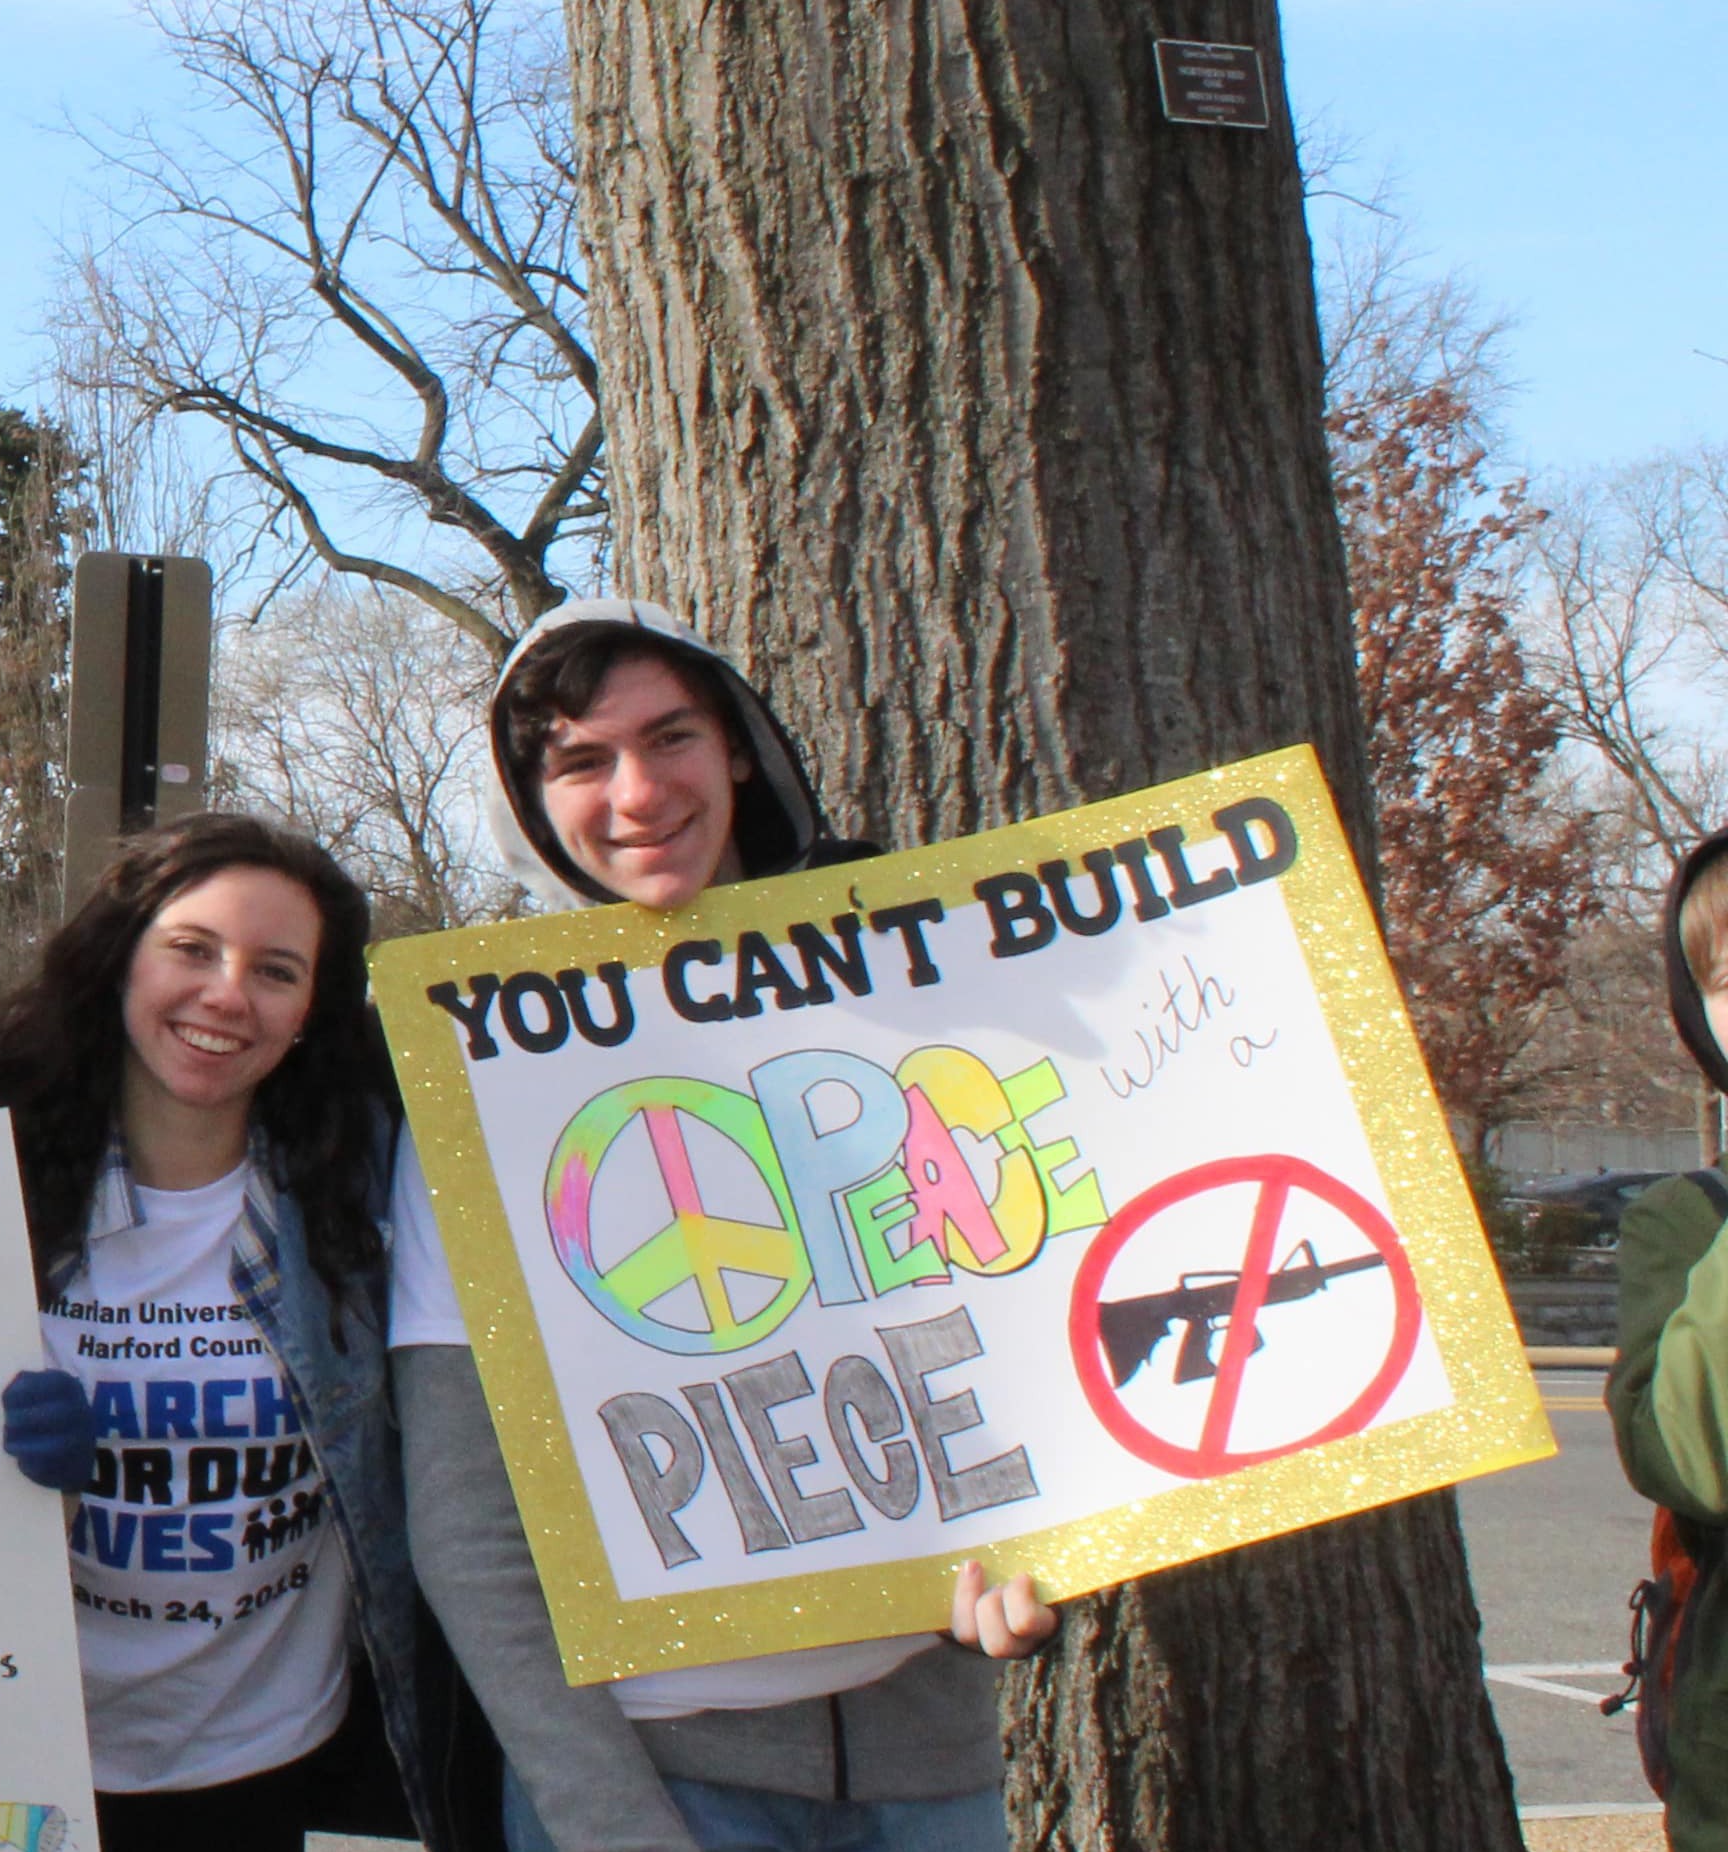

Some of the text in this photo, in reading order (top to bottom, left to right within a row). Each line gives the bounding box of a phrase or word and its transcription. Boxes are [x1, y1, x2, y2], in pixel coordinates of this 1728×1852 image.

[428, 798, 1300, 1062] YOU CAN'T BUILD
[1099, 954, 1235, 1098] with
[1230, 1027, 1278, 1067] a
[748, 1043, 1112, 1308] PEACE
[137, 1301, 253, 1325] Univers
[77, 1332, 267, 1361] Harford Coun
[93, 1376, 303, 1440] ARCH
[596, 1305, 1040, 1571] PIECE
[82, 1440, 318, 1506] OR OU
[70, 1502, 235, 1573] IVES
[73, 1583, 153, 1622] arch
[164, 1599, 224, 1630] 24,
